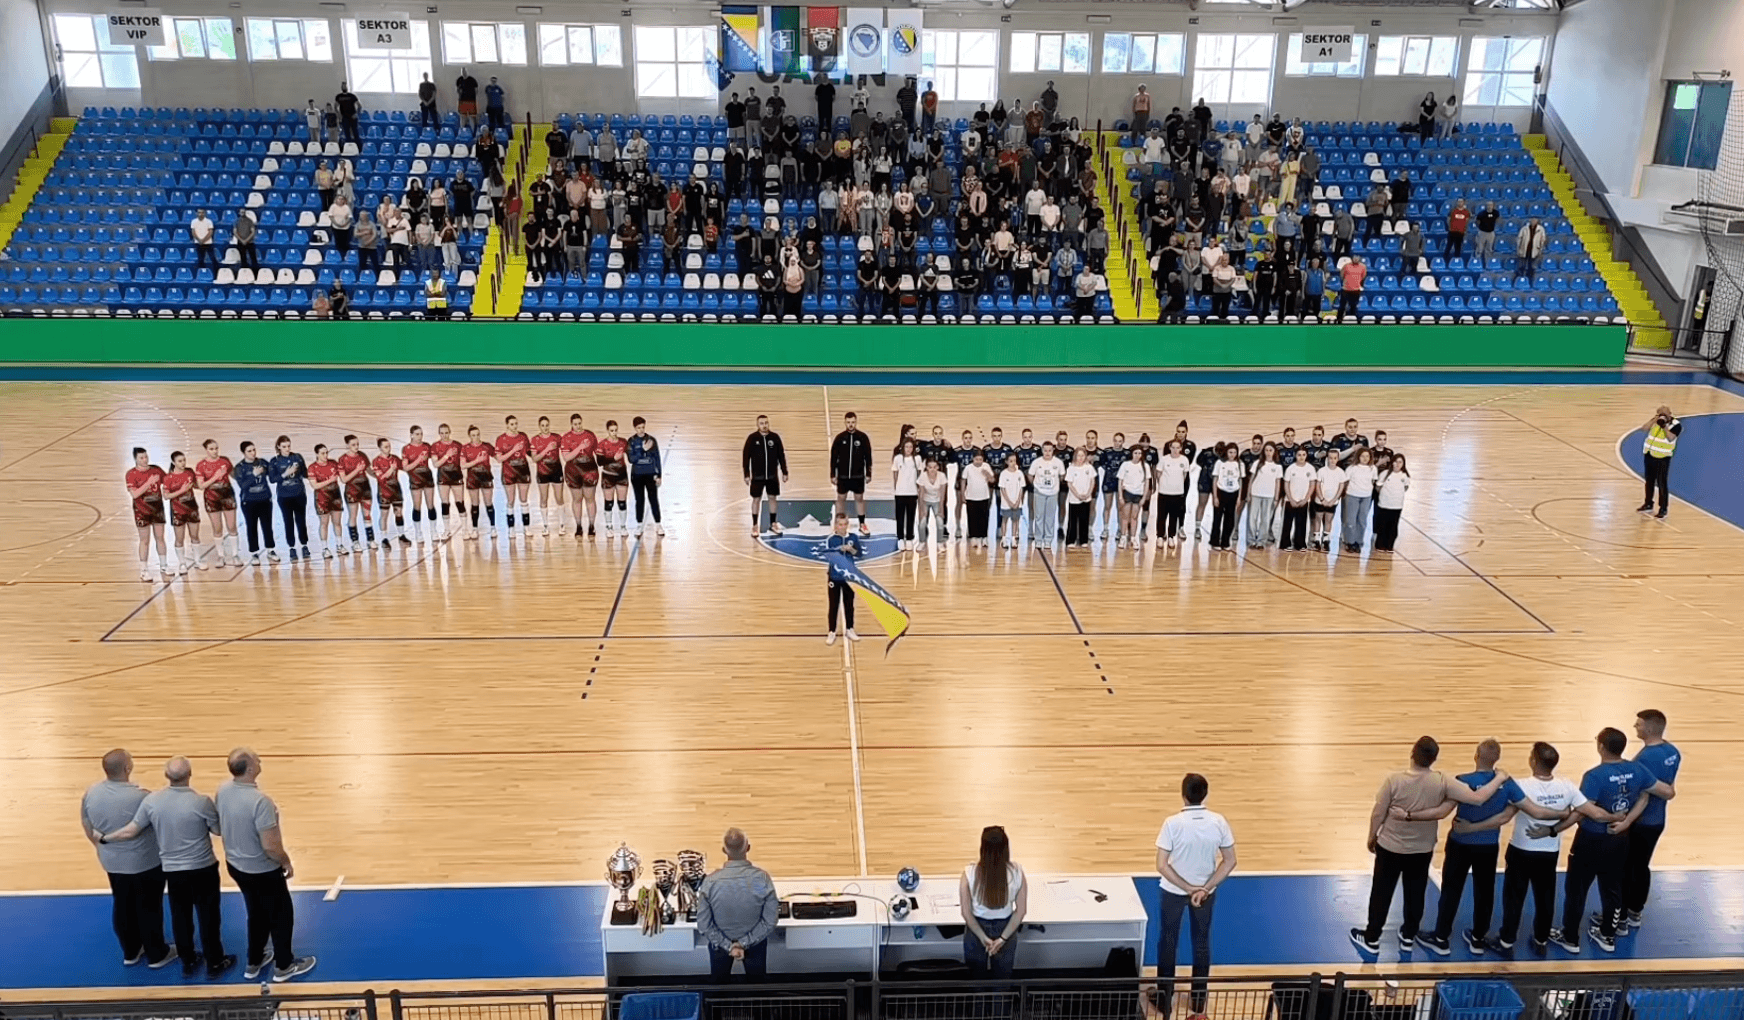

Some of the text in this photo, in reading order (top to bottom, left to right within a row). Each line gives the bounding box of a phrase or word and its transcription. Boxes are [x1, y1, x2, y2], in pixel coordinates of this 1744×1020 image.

[110, 15, 161, 27] SEKTOR
[359, 20, 408, 30] SEKTOR
[126, 29, 147, 39] VIP
[377, 33, 393, 44] A3
[1304, 34, 1351, 44] SEKTOR
[1319, 47, 1333, 57] A1
